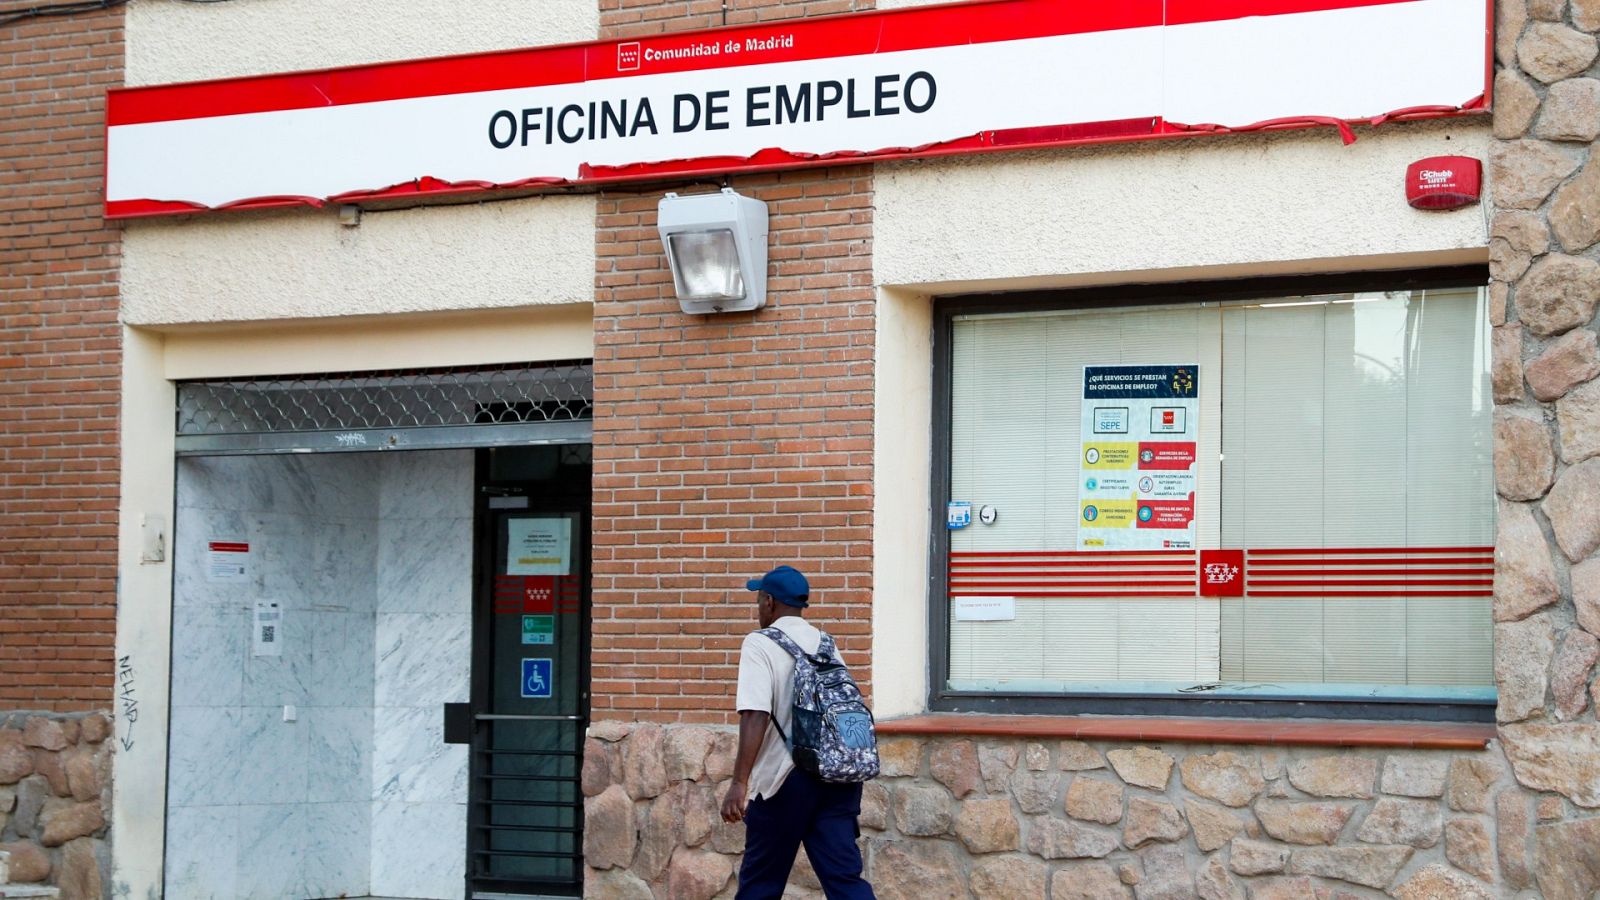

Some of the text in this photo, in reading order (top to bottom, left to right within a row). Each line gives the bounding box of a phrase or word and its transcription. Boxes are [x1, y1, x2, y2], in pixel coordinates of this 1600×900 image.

[643, 35, 794, 62] Comunidad de Madrid
[488, 71, 937, 149] OFICINA DE EMPLEO
[1428, 170, 1453, 178] Chubb
[1100, 421, 1120, 430] SEPE
